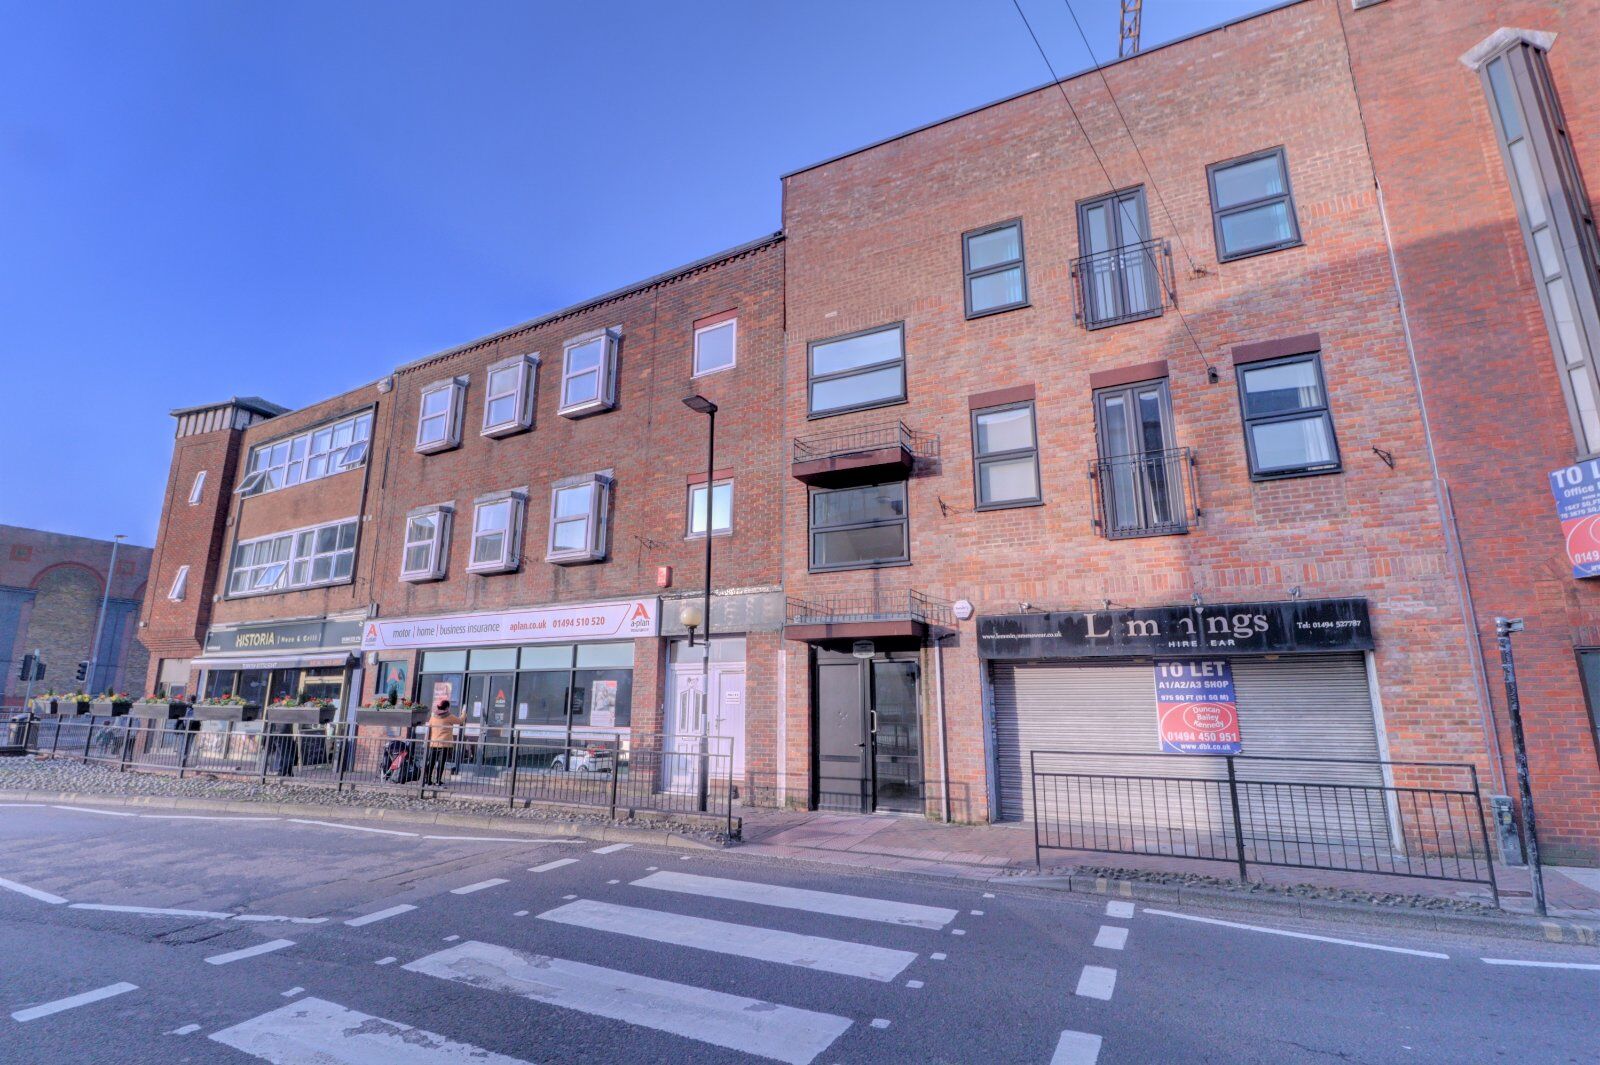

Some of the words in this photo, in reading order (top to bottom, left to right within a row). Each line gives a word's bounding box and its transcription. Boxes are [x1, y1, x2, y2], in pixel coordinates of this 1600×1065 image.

[1552, 466, 1583, 488] TO
[1564, 484, 1595, 498] Office
[393, 629, 411, 638] motor
[416, 627, 434, 636] home
[439, 625, 466, 636] business
[467, 623, 500, 633] insurance
[510, 619, 547, 632] aplan.co.uk
[552, 618, 574, 628] 01494
[576, 617, 590, 627] 510
[591, 616, 605, 626] 520
[1296, 621, 1311, 629] Tel:
[1312, 621, 1334, 629] 01494
[235, 632, 275, 647] HISTORIA
[1158, 662, 1184, 678] TO
[1190, 661, 1226, 677] LET
[1159, 681, 1202, 689] A1/A2/A3
[1204, 680, 1229, 689] SHOP
[1192, 706, 1220, 714] Duncan
[1197, 713, 1219, 722] Bailey
[1193, 719, 1224, 729] Kennedy
[1167, 731, 1195, 741] 01494
[1198, 732, 1217, 741] 450
[1219, 732, 1237, 742] 951
